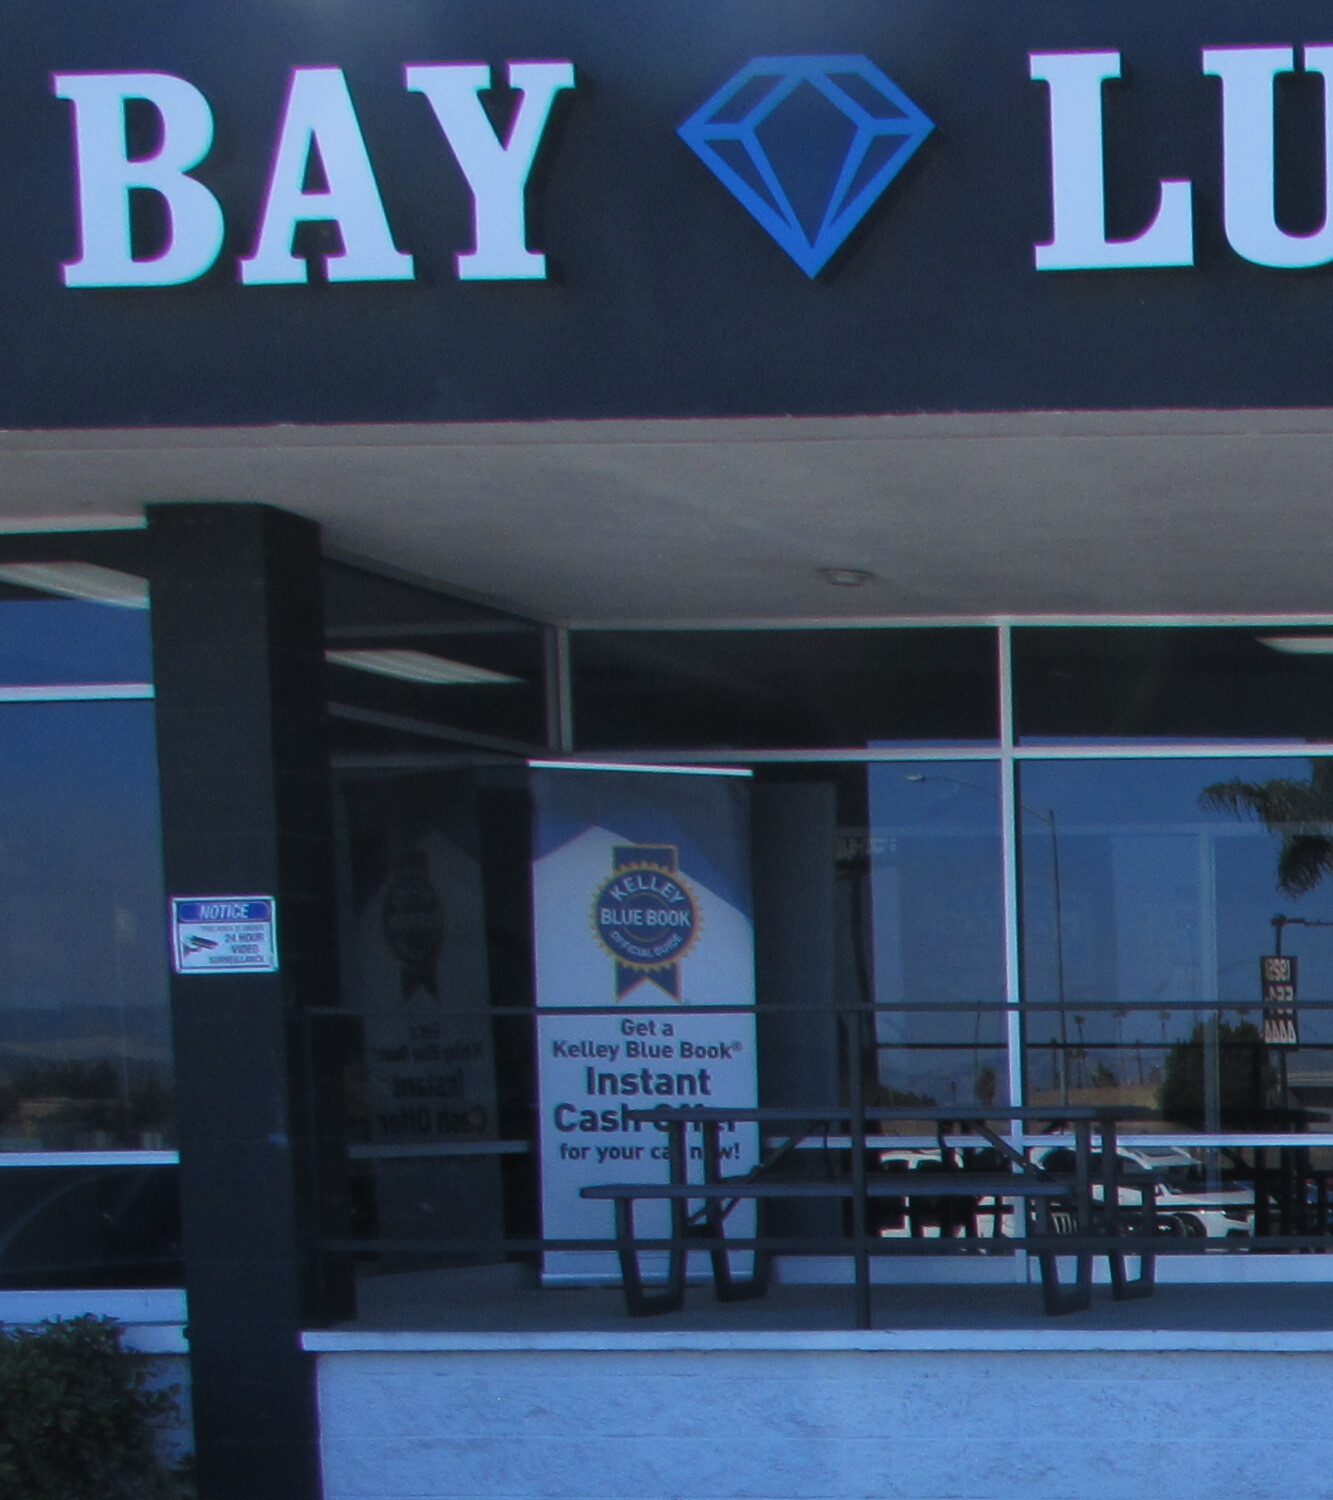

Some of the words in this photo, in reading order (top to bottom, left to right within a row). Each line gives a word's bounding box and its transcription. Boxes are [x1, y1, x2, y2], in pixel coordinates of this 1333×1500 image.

[52, 62, 577, 288] BAY
[609, 874, 686, 902] KELLEY
[200, 903, 250, 920] NOTICE
[600, 908, 643, 926] BLUE
[646, 909, 692, 927] BOOK
[620, 1018, 658, 1036] Get
[661, 1021, 675, 1036] a
[552, 1040, 621, 1062] Kelley
[625, 1040, 674, 1059] Blue
[586, 1065, 713, 1096] Instant
[553, 1102, 643, 1133] Cash
[559, 1142, 592, 1160] for
[594, 1146, 645, 1164] your
[651, 1146, 680, 1160] ca
[690, 1142, 741, 1160] nw!
